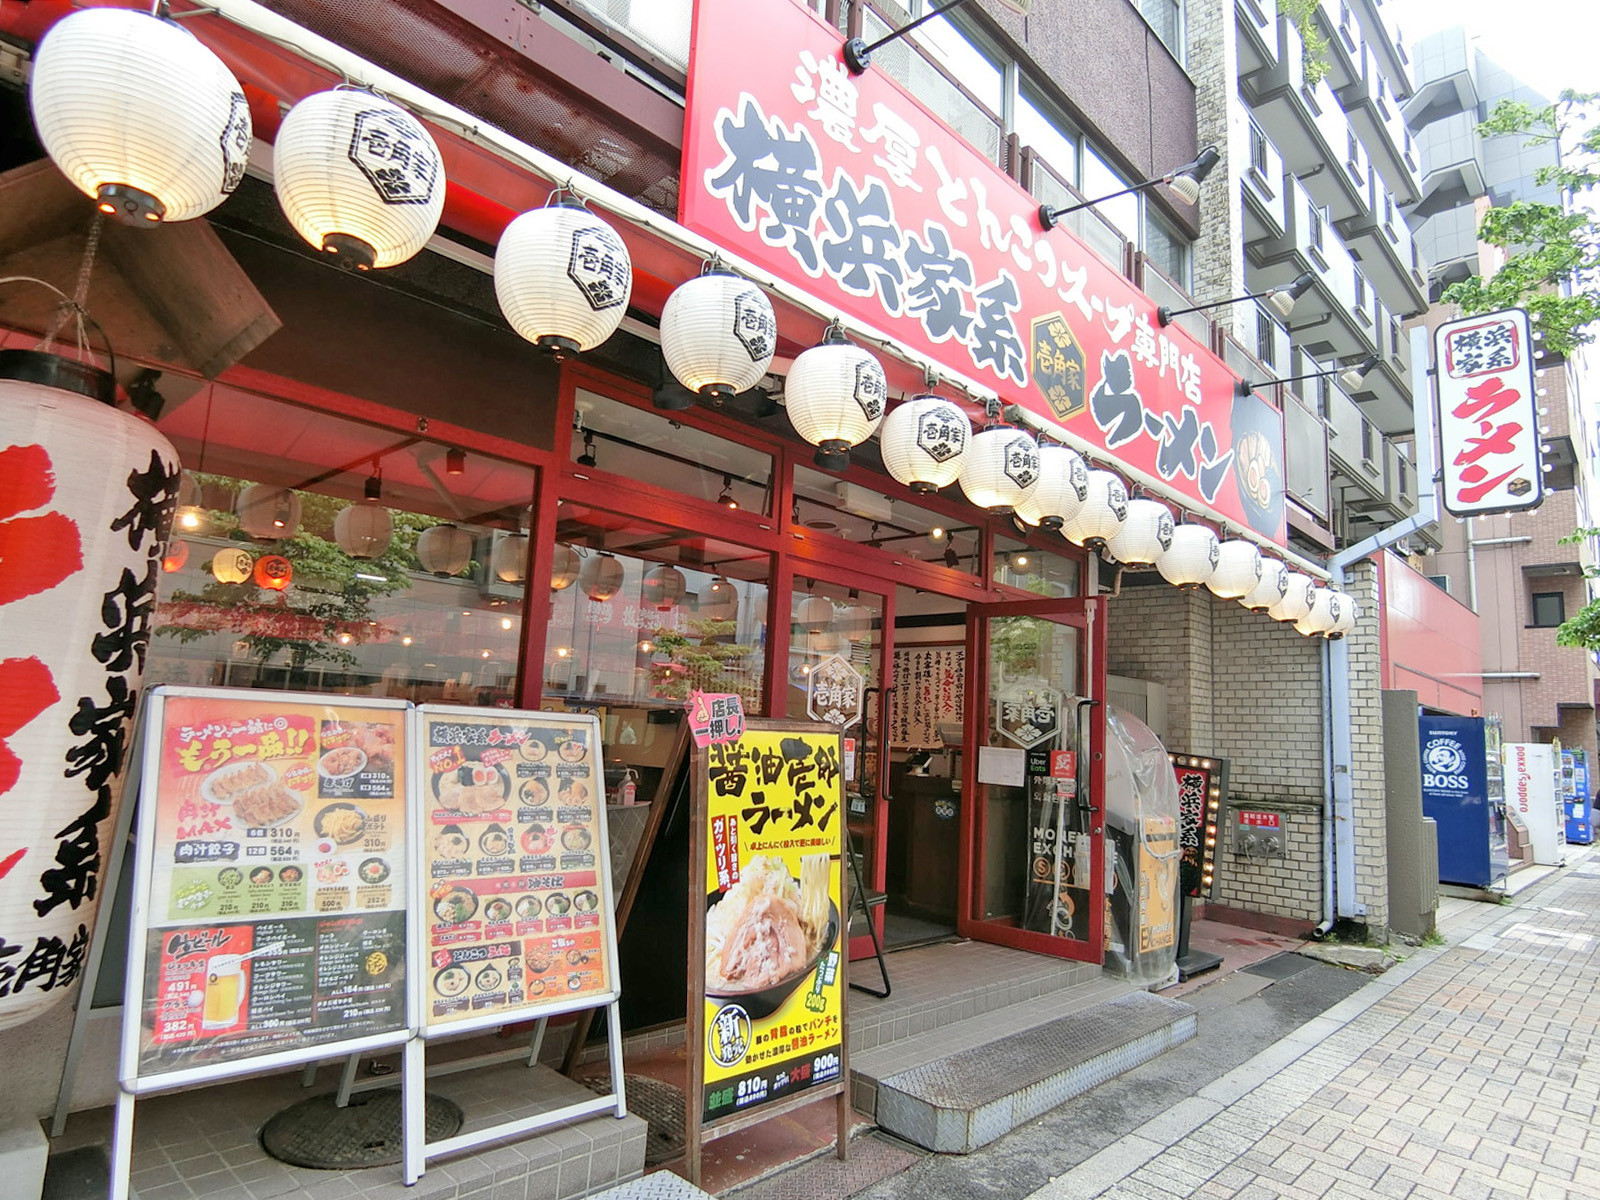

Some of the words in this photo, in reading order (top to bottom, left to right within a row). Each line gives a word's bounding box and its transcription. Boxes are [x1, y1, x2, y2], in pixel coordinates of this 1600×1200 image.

[704, 92, 1028, 388] 横浜家系
[1089, 348, 1235, 504] ラーメン
[1453, 325, 1512, 353] 横浜
[1036, 340, 1081, 391] 壱角家
[1456, 347, 1512, 373] 家系
[924, 422, 960, 444] 壱角家
[1452, 377, 1524, 503] ラーメン
[711, 697, 740, 717] 店長
[814, 681, 856, 708] 壱角家
[694, 717, 743, 740] 一押し!
[1426, 738, 1462, 750] COFFEE
[1423, 774, 1469, 789] BOSS
[742, 791, 838, 836] ラーメン
[717, 1008, 741, 1044] 新
[737, 1076, 768, 1097] 810円
